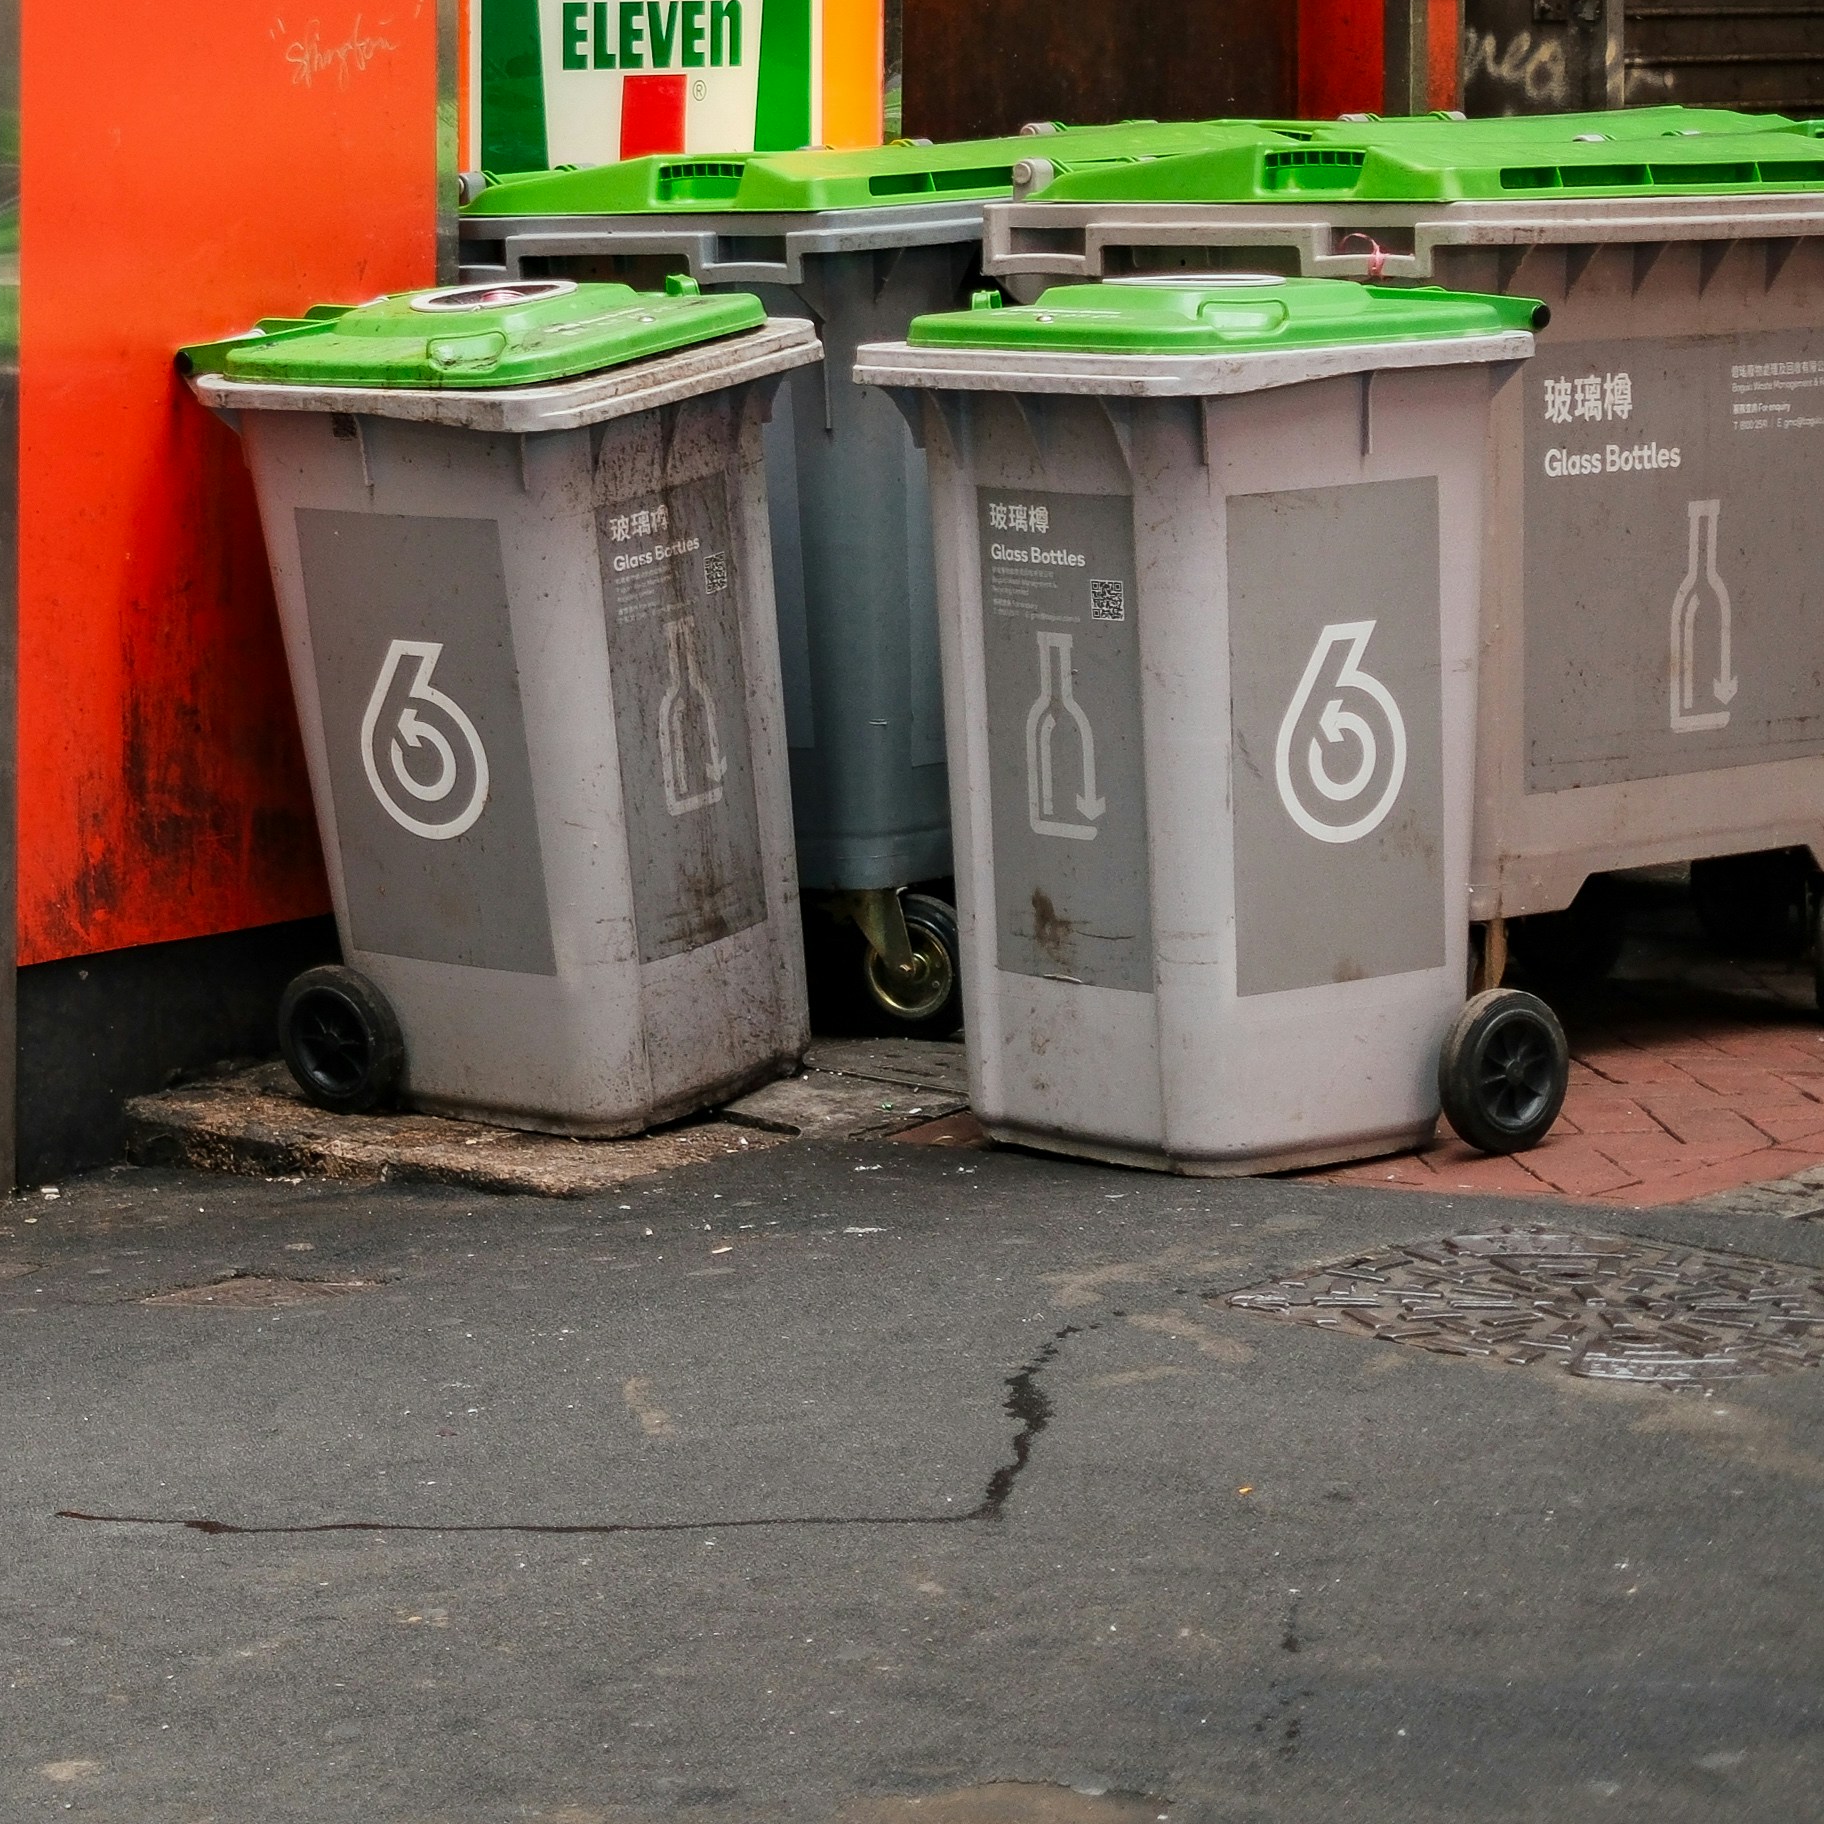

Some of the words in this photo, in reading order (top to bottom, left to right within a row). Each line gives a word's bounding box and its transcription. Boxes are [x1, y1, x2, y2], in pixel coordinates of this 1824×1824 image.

[1544, 373, 1633, 423] 玻璃樽
[1544, 448, 1601, 477] Glass
[1606, 441, 1681, 472] Bottles
[989, 502, 1050, 534] 玻璃樽
[613, 552, 653, 572] Glass
[990, 543, 1029, 563] Glass
[1030, 546, 1086, 567] Bottles
